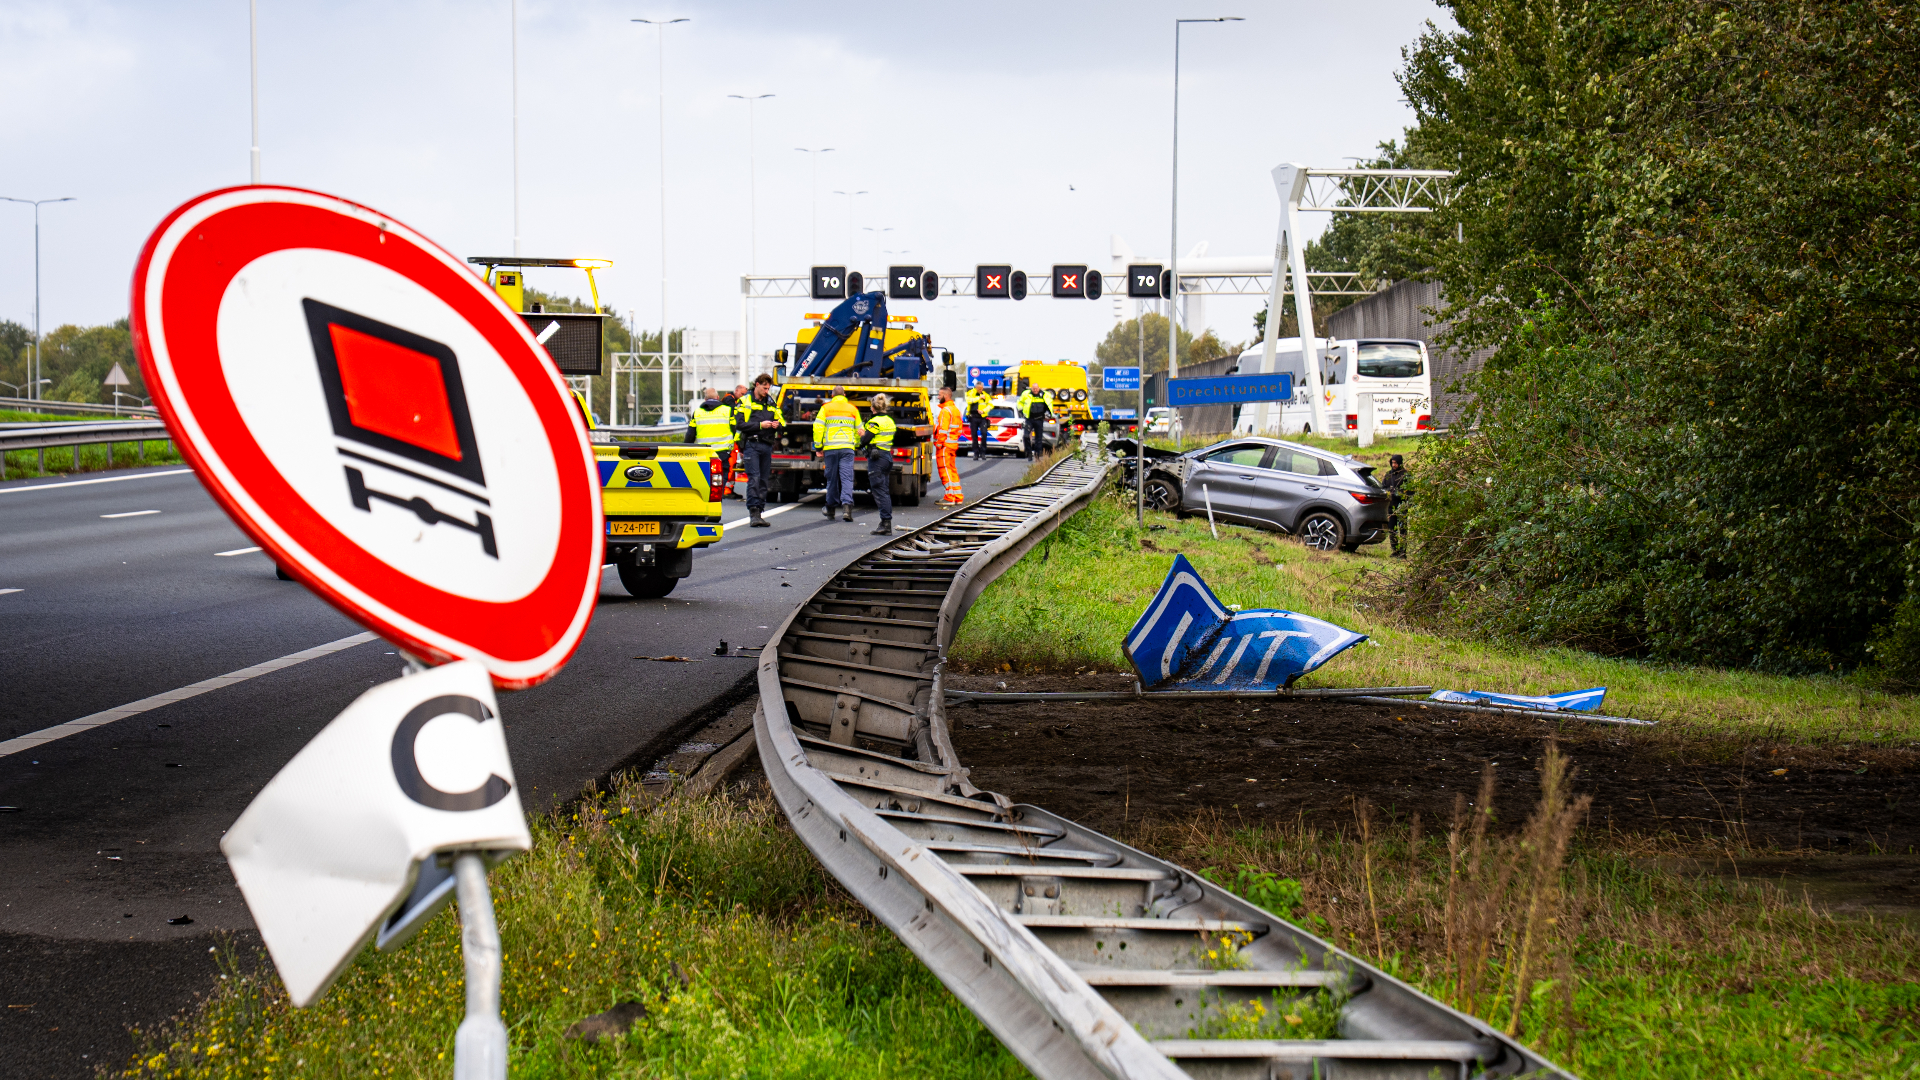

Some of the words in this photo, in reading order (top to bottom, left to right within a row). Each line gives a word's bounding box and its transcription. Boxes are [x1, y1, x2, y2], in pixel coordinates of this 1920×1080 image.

[822, 277, 840, 288] 70
[898, 277, 916, 288] 70
[1138, 276, 1155, 286] 70
[1177, 381, 1283, 398] Drechttunnel
[633, 469, 648, 477] Ford
[613, 523, 656, 533] V-24-PTF
[1160, 610, 1313, 685] UIT
[390, 694, 512, 812] C
